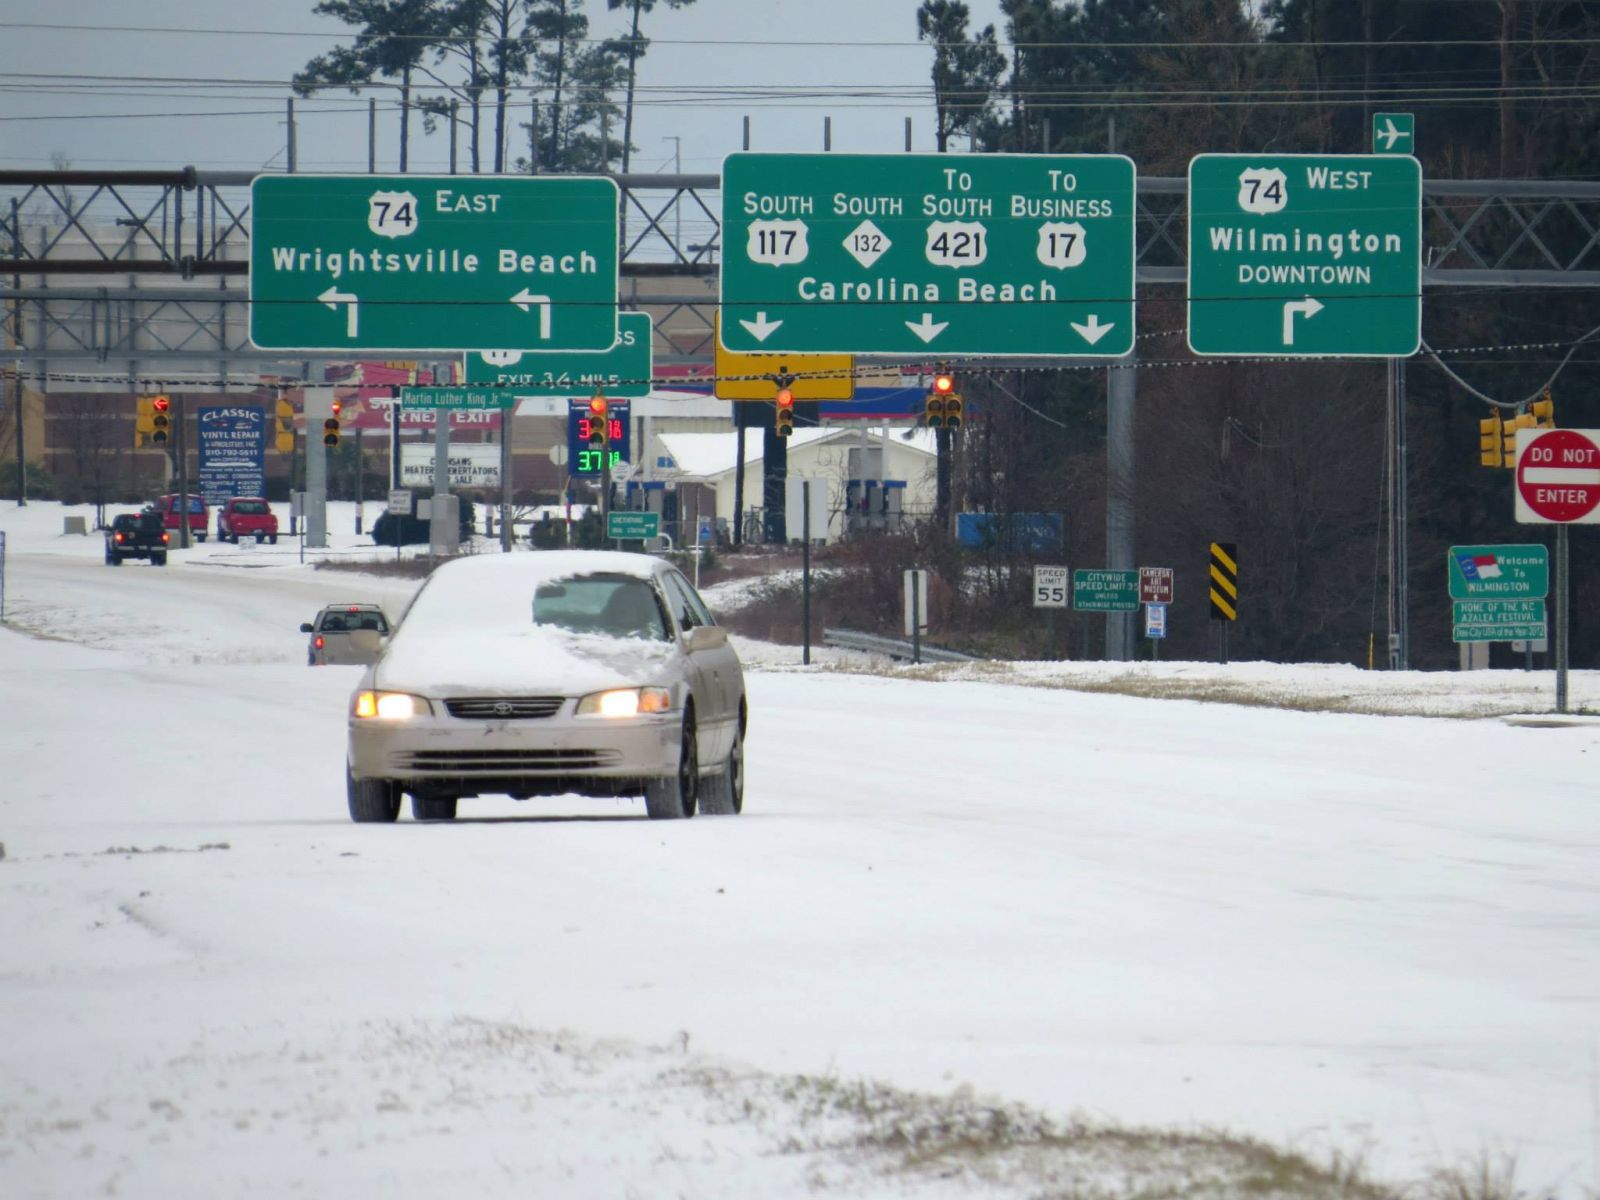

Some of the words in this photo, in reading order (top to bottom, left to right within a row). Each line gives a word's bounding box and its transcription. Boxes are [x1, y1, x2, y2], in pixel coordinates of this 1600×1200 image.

[1307, 167, 1372, 189] WEST
[1245, 179, 1282, 204] 74
[436, 190, 501, 212] EAST
[743, 192, 813, 215] SOUTH
[833, 193, 902, 216] SOUTH
[922, 195, 992, 217] SOUTH
[1011, 195, 1112, 218] BUSINESS
[373, 202, 412, 227] 74
[758, 230, 797, 256] 117
[853, 234, 881, 253] 132
[931, 232, 981, 258] 421
[1049, 232, 1077, 259] 17
[1210, 227, 1401, 260] Wilmington
[272, 248, 479, 279] Wrightsville
[499, 250, 597, 273] Beach
[1239, 265, 1371, 284] DOWNTOWN
[798, 277, 939, 301] Carolina
[958, 279, 1056, 302] Beach
[498, 374, 533, 387] EXIT
[580, 374, 619, 387] MILE
[405, 393, 432, 405] Martin
[435, 393, 464, 405] Luther
[467, 393, 486, 408] King
[202, 408, 260, 422] CLASSIC
[410, 412, 436, 423] NEX
[456, 412, 492, 423] EXIT
[202, 431, 229, 439] VINYL
[231, 431, 260, 439] REPAIR
[1532, 447, 1553, 462] DO
[1563, 448, 1595, 463] NOT
[454, 476, 473, 484] SALE
[1537, 489, 1588, 504] ENTER
[1497, 556, 1544, 565] Welcome
[1037, 569, 1065, 577] SPEED
[1087, 573, 1126, 581] CITYWIDE
[1143, 568, 1170, 577] CAMERON
[1513, 568, 1526, 577] To
[1075, 581, 1103, 590] SPEED
[1104, 582, 1126, 591] LIMIT
[1150, 577, 1161, 585] ART
[1468, 582, 1529, 592] WILMINGTON
[1038, 587, 1063, 602] 55
[1144, 585, 1169, 594] MUSEUM
[1461, 602, 1484, 612] HOME
[1488, 602, 1498, 611] OF
[1503, 602, 1518, 611] THE
[1461, 613, 1494, 622] AZALEA
[1497, 613, 1536, 621] FESTIVAL
